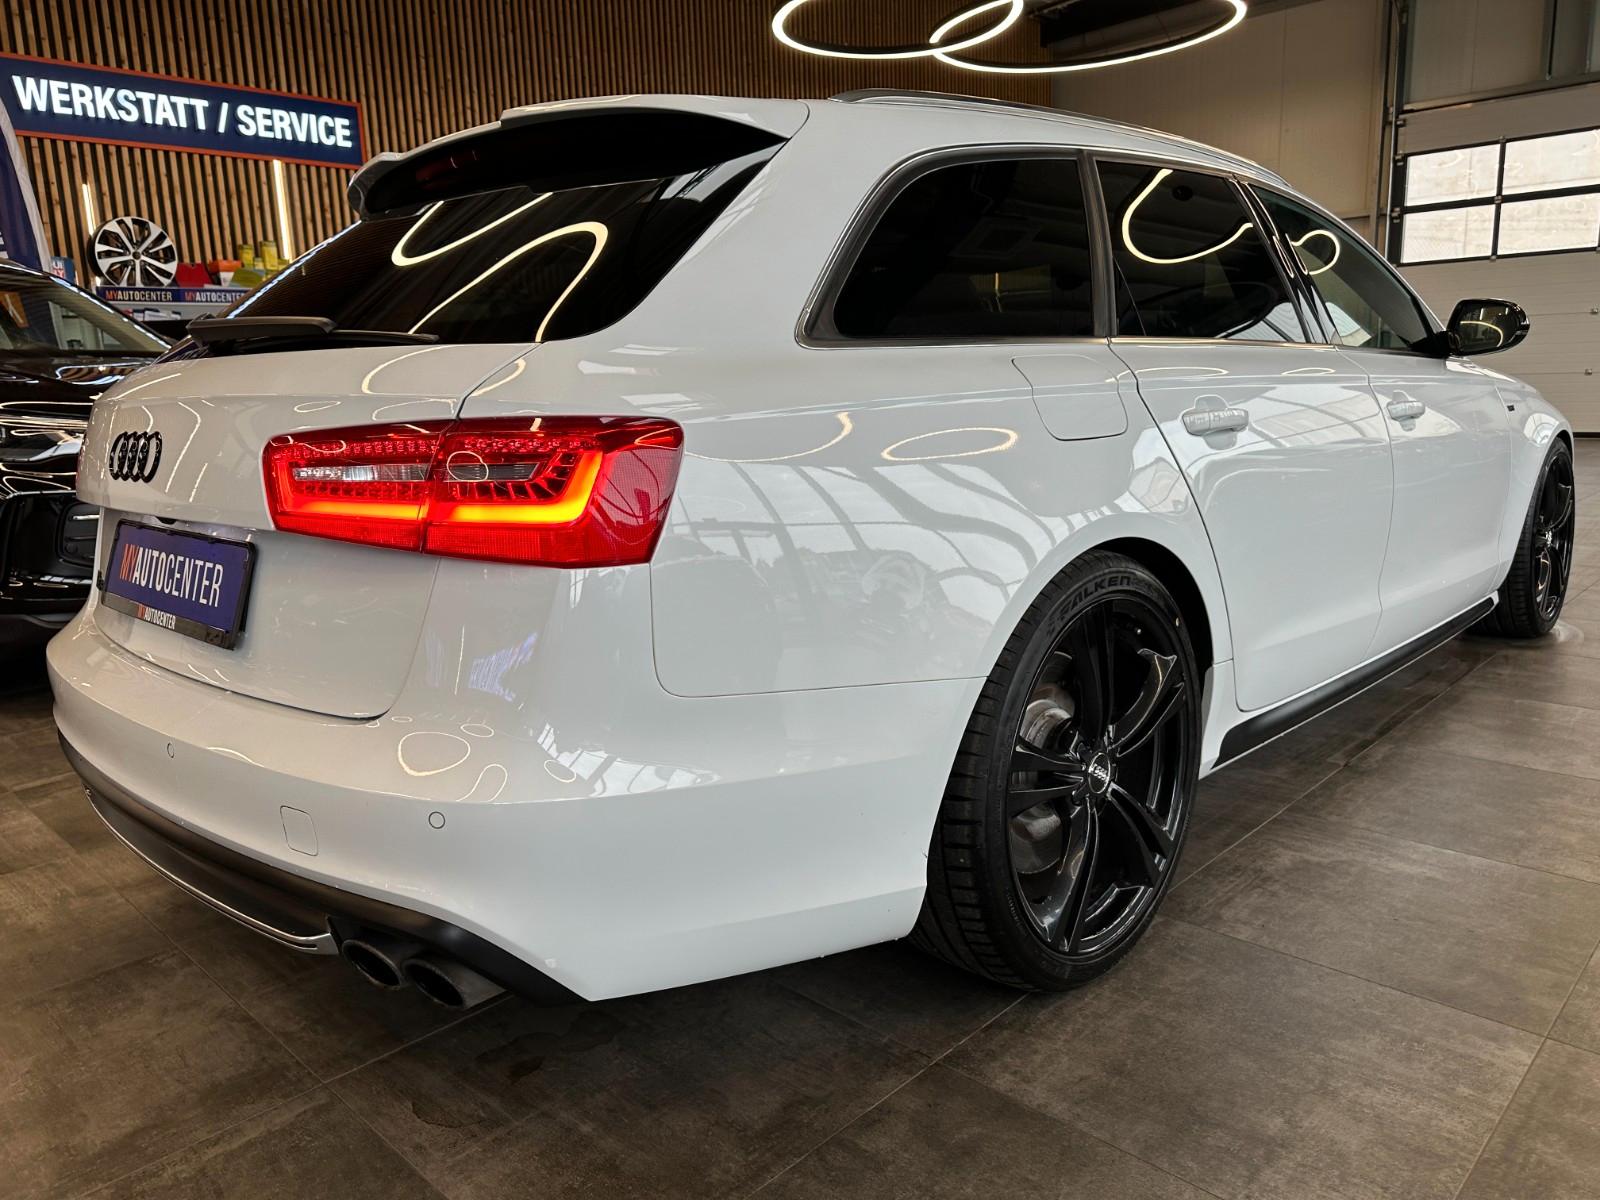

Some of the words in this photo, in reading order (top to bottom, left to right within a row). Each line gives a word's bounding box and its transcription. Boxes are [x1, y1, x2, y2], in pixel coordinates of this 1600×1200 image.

[12, 74, 209, 131] WERKSTATT
[218, 102, 230, 134] /
[237, 104, 354, 149] SERVICE
[105, 290, 173, 302] MYAUTOCENTER
[119, 543, 224, 608] MYAUTOCENTER
[137, 603, 176, 630] MYAUTOCENTER
